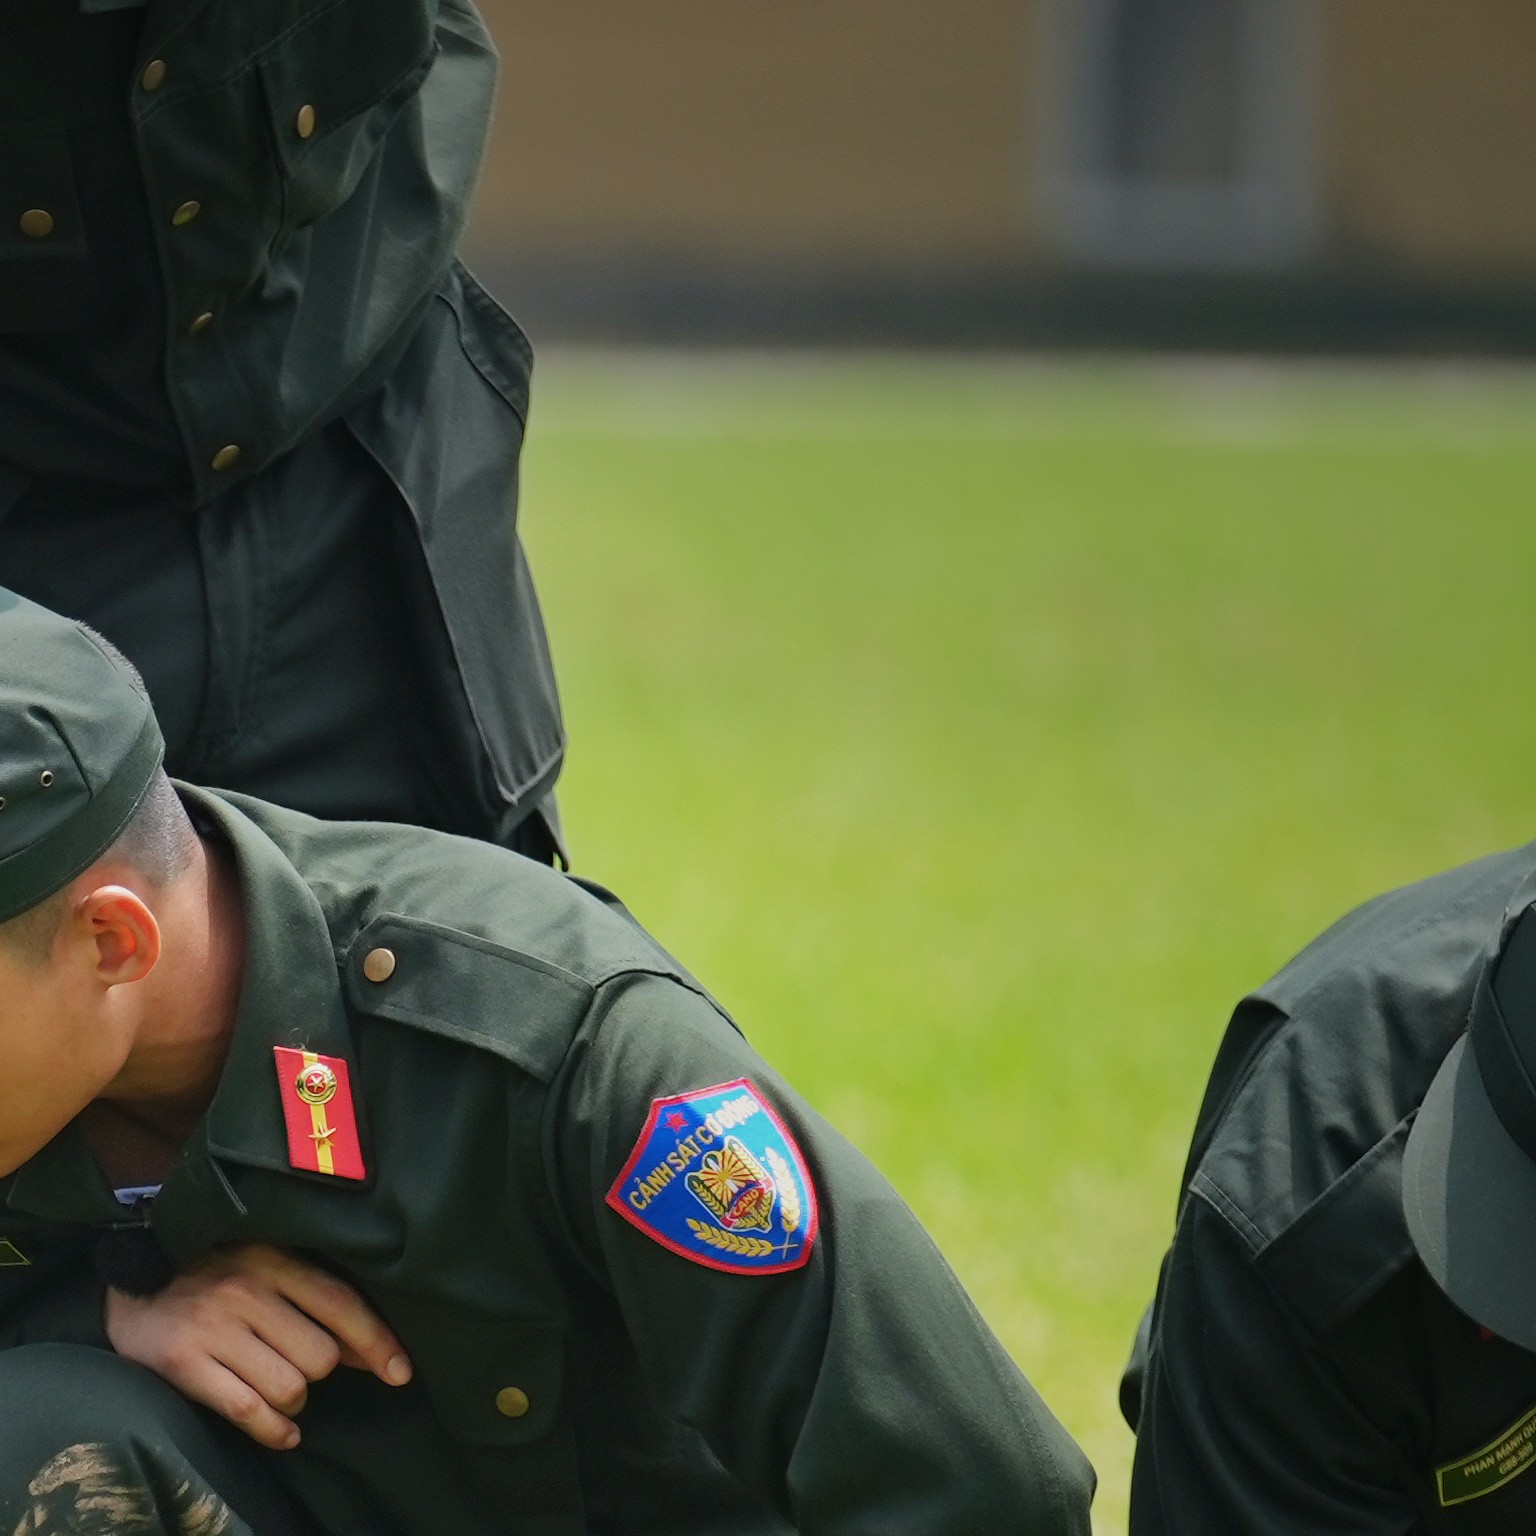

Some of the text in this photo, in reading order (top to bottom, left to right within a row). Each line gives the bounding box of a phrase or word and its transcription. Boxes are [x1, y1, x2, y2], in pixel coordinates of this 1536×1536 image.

[629, 1162, 676, 1210] CẢNH
[666, 1135, 702, 1173] SÁT
[696, 1113, 724, 1145] CƠ
[732, 1188, 760, 1216] CAND
